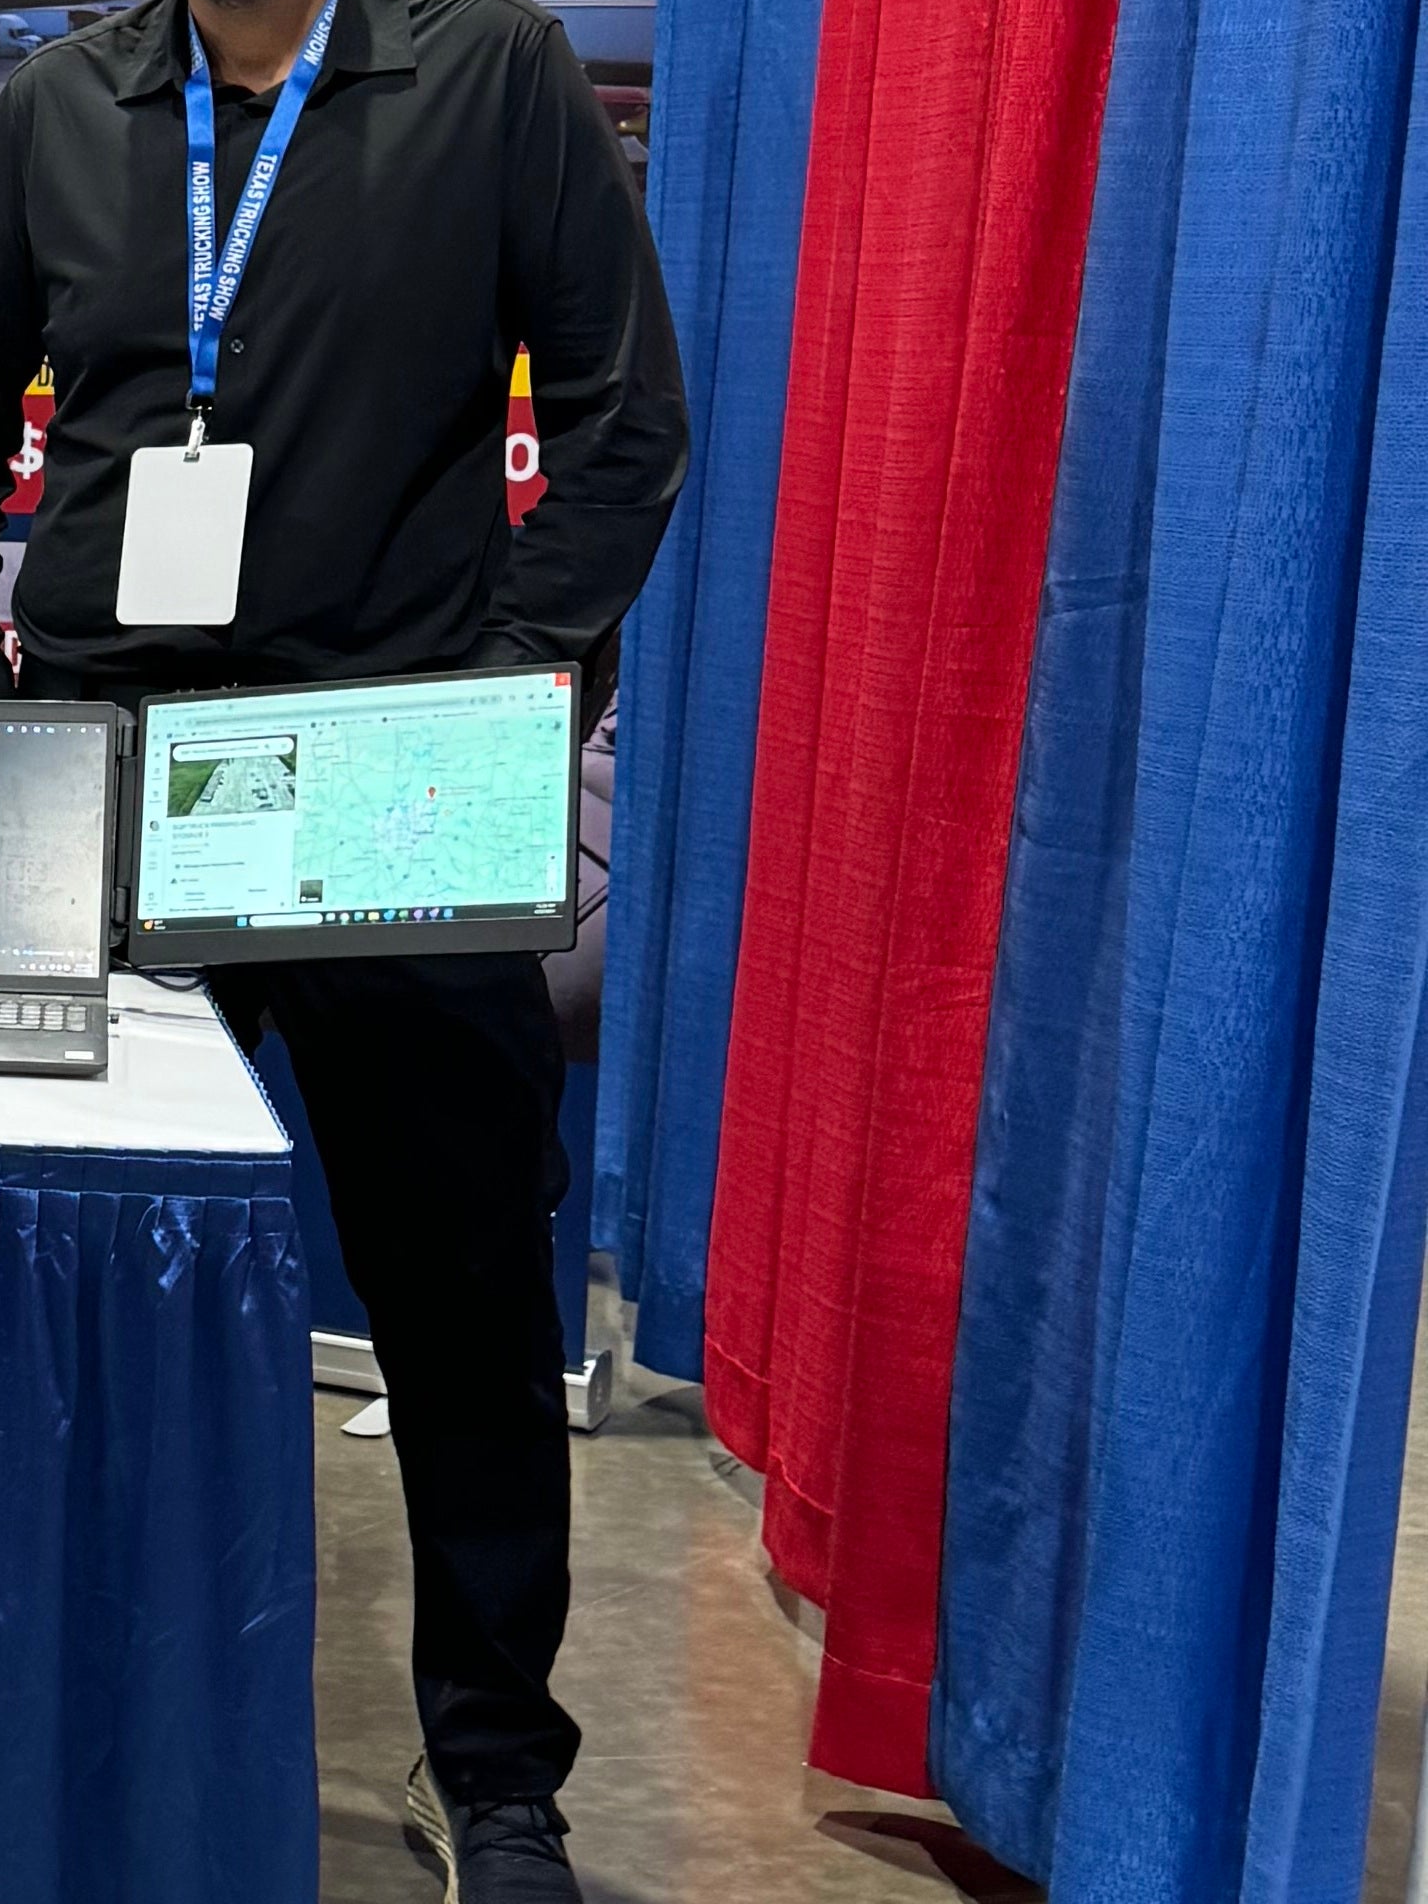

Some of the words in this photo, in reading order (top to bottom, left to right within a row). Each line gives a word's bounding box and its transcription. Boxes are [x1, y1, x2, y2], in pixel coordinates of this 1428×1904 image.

[303, 19, 331, 66] SHOW
[192, 161, 211, 204] SHOW
[246, 154, 278, 200] TEXAS
[192, 205, 212, 282] TRUCKING
[222, 201, 261, 275] TRUCKING
[193, 283, 212, 332] TEXAS
[208, 275, 238, 322] SHOW
